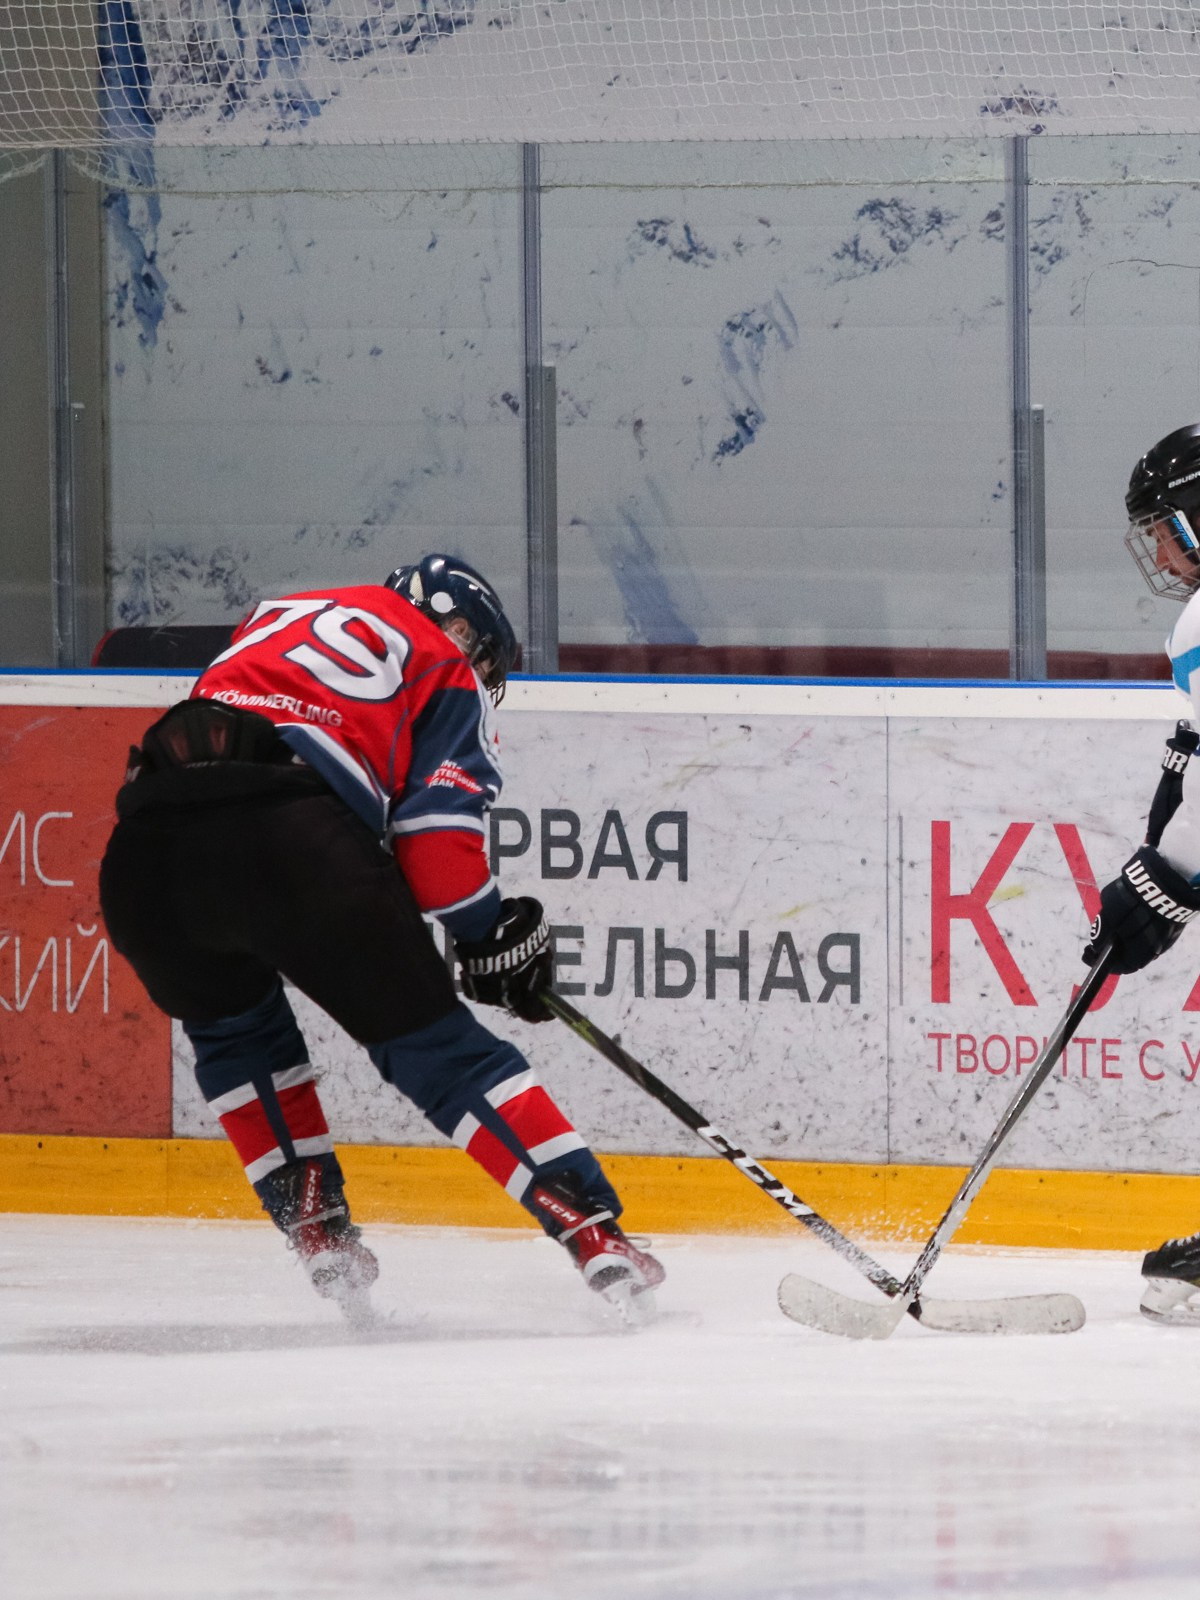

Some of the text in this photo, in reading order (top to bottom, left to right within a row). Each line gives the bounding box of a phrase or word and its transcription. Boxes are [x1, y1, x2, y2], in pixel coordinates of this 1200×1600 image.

[207, 599, 403, 700] 79
[211, 690, 343, 727] KÖMMERLING
[490, 807, 688, 882] РВАЯ
[0, 923, 109, 1014] ИЙ
[424, 922, 861, 1005] ЕЛЬНАЯ
[1138, 1039, 1165, 1081] С
[538, 1195, 578, 1223] CCM
[697, 1125, 816, 1217] CCM
